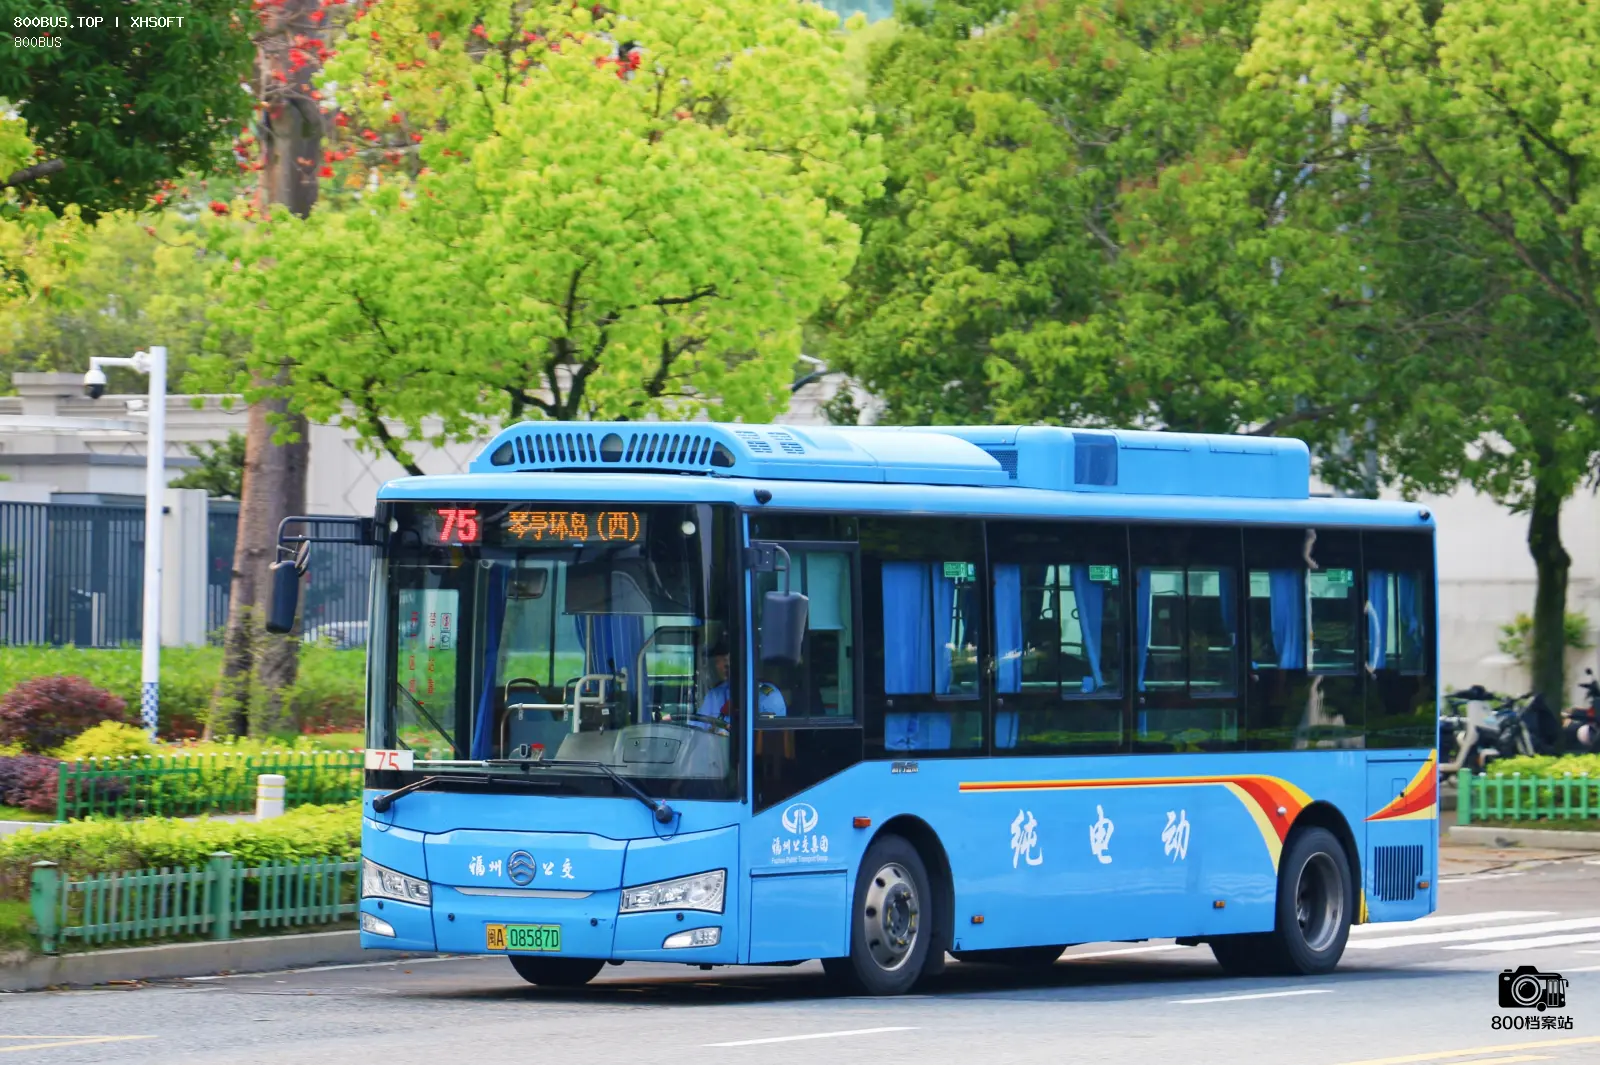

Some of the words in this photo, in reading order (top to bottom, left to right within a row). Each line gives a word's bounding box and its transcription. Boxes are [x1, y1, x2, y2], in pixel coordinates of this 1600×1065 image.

[437, 509, 478, 542] 75
[375, 751, 400, 771] 75
[771, 834, 829, 855] 福州公交集团
[1010, 804, 1191, 869] 纯电动
[468, 855, 503, 877] 福州
[541, 857, 576, 880] 公交
[510, 928, 560, 948] 08587D
